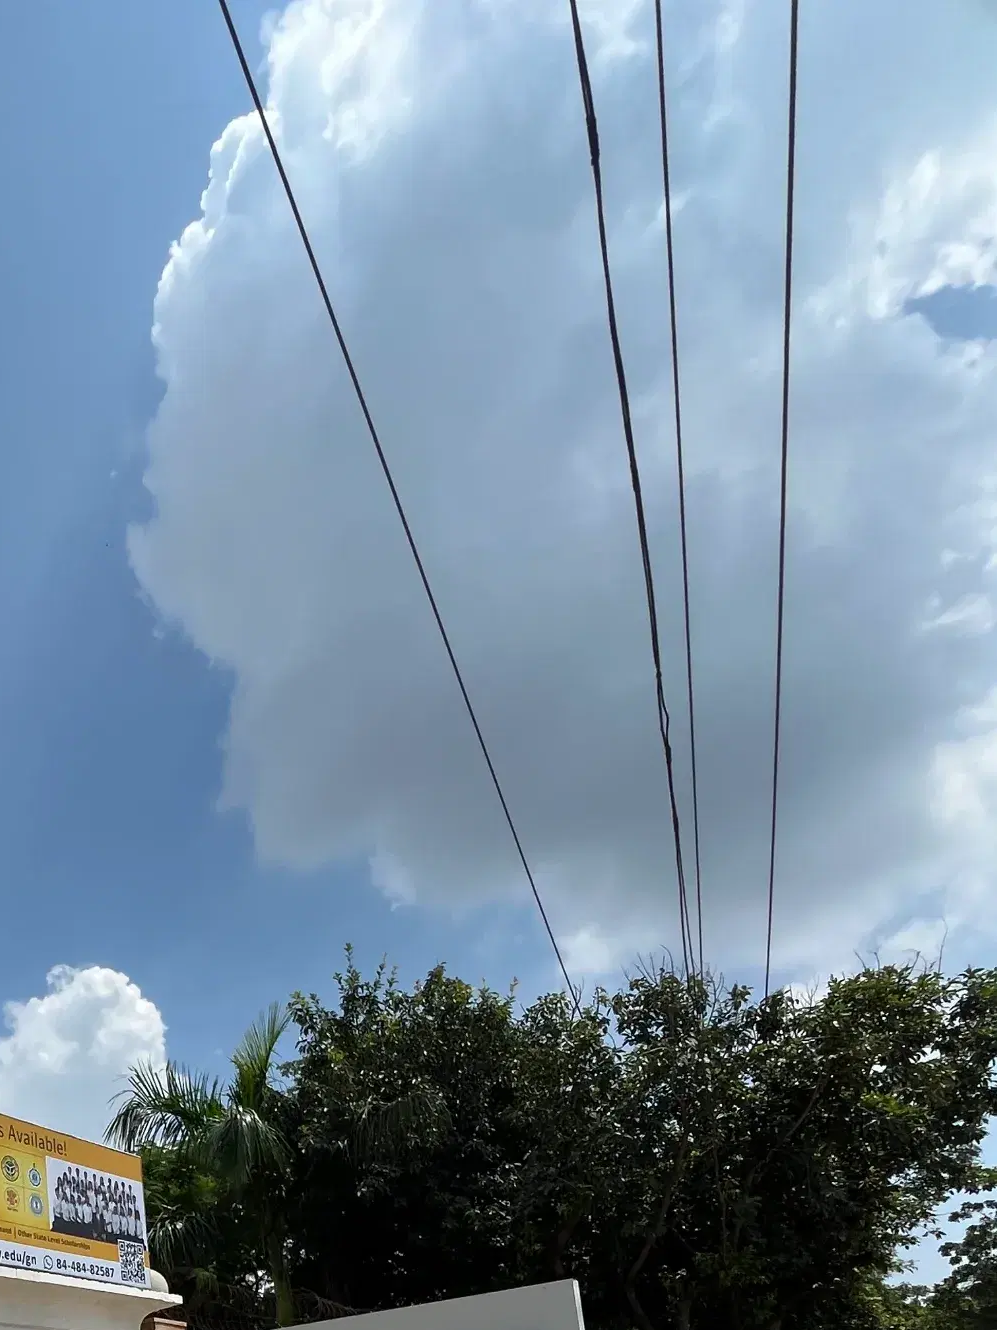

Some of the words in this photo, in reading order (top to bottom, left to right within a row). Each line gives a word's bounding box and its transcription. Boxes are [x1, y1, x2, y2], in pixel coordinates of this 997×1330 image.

[8, 1124, 68, 1156] Available!
[17, 1228, 33, 1239] Other
[33, 1232, 47, 1242] State
[47, 1235, 61, 1245] Level
[61, 1238, 91, 1251] Scholarships
[56, 1258, 115, 1278] 84-484-82587
